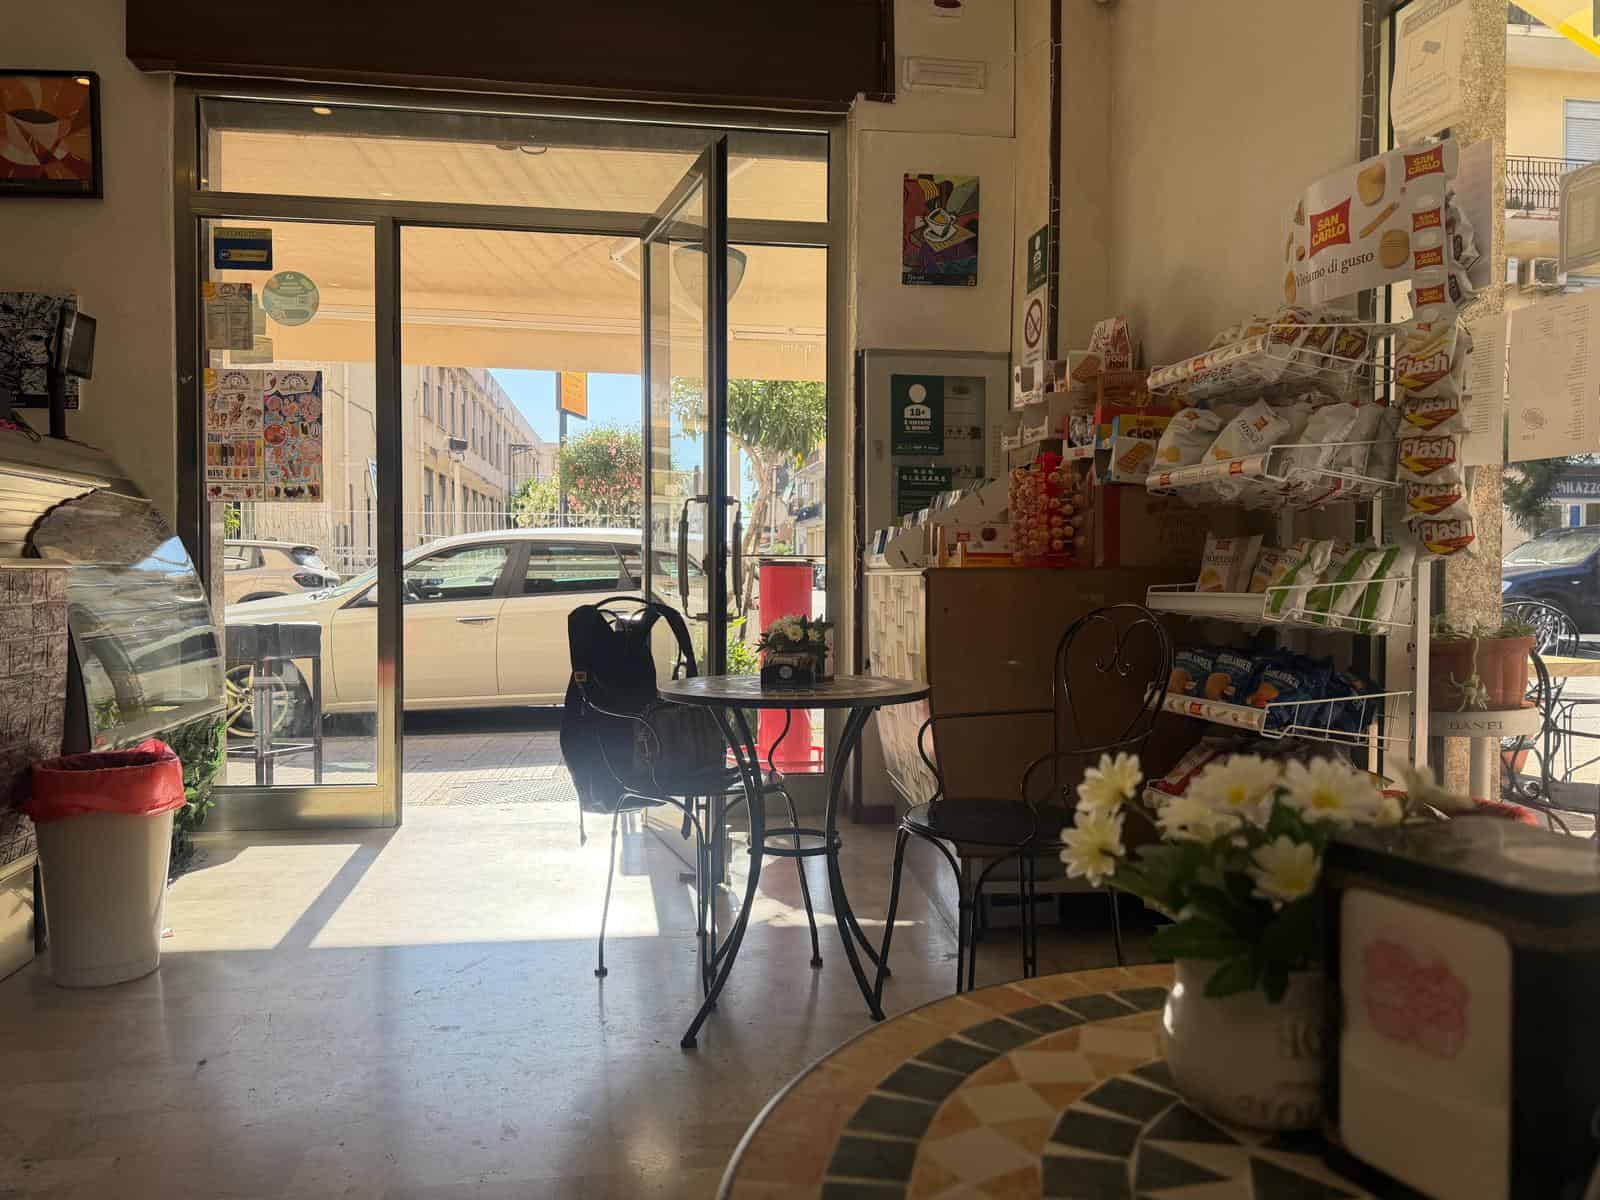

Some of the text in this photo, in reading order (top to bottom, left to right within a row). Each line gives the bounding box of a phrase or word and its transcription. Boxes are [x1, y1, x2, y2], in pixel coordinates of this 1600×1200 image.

[1407, 160, 1440, 175] CARLO
[1411, 153, 1434, 168] SAN
[1317, 212, 1339, 231] SAN
[1311, 222, 1346, 248] CARLO
[1328, 258, 1338, 273] di
[1341, 251, 1375, 274] gusto
[1396, 351, 1450, 376] Flash
[1400, 437, 1456, 460] Flash
[1423, 519, 1474, 542] Flash
